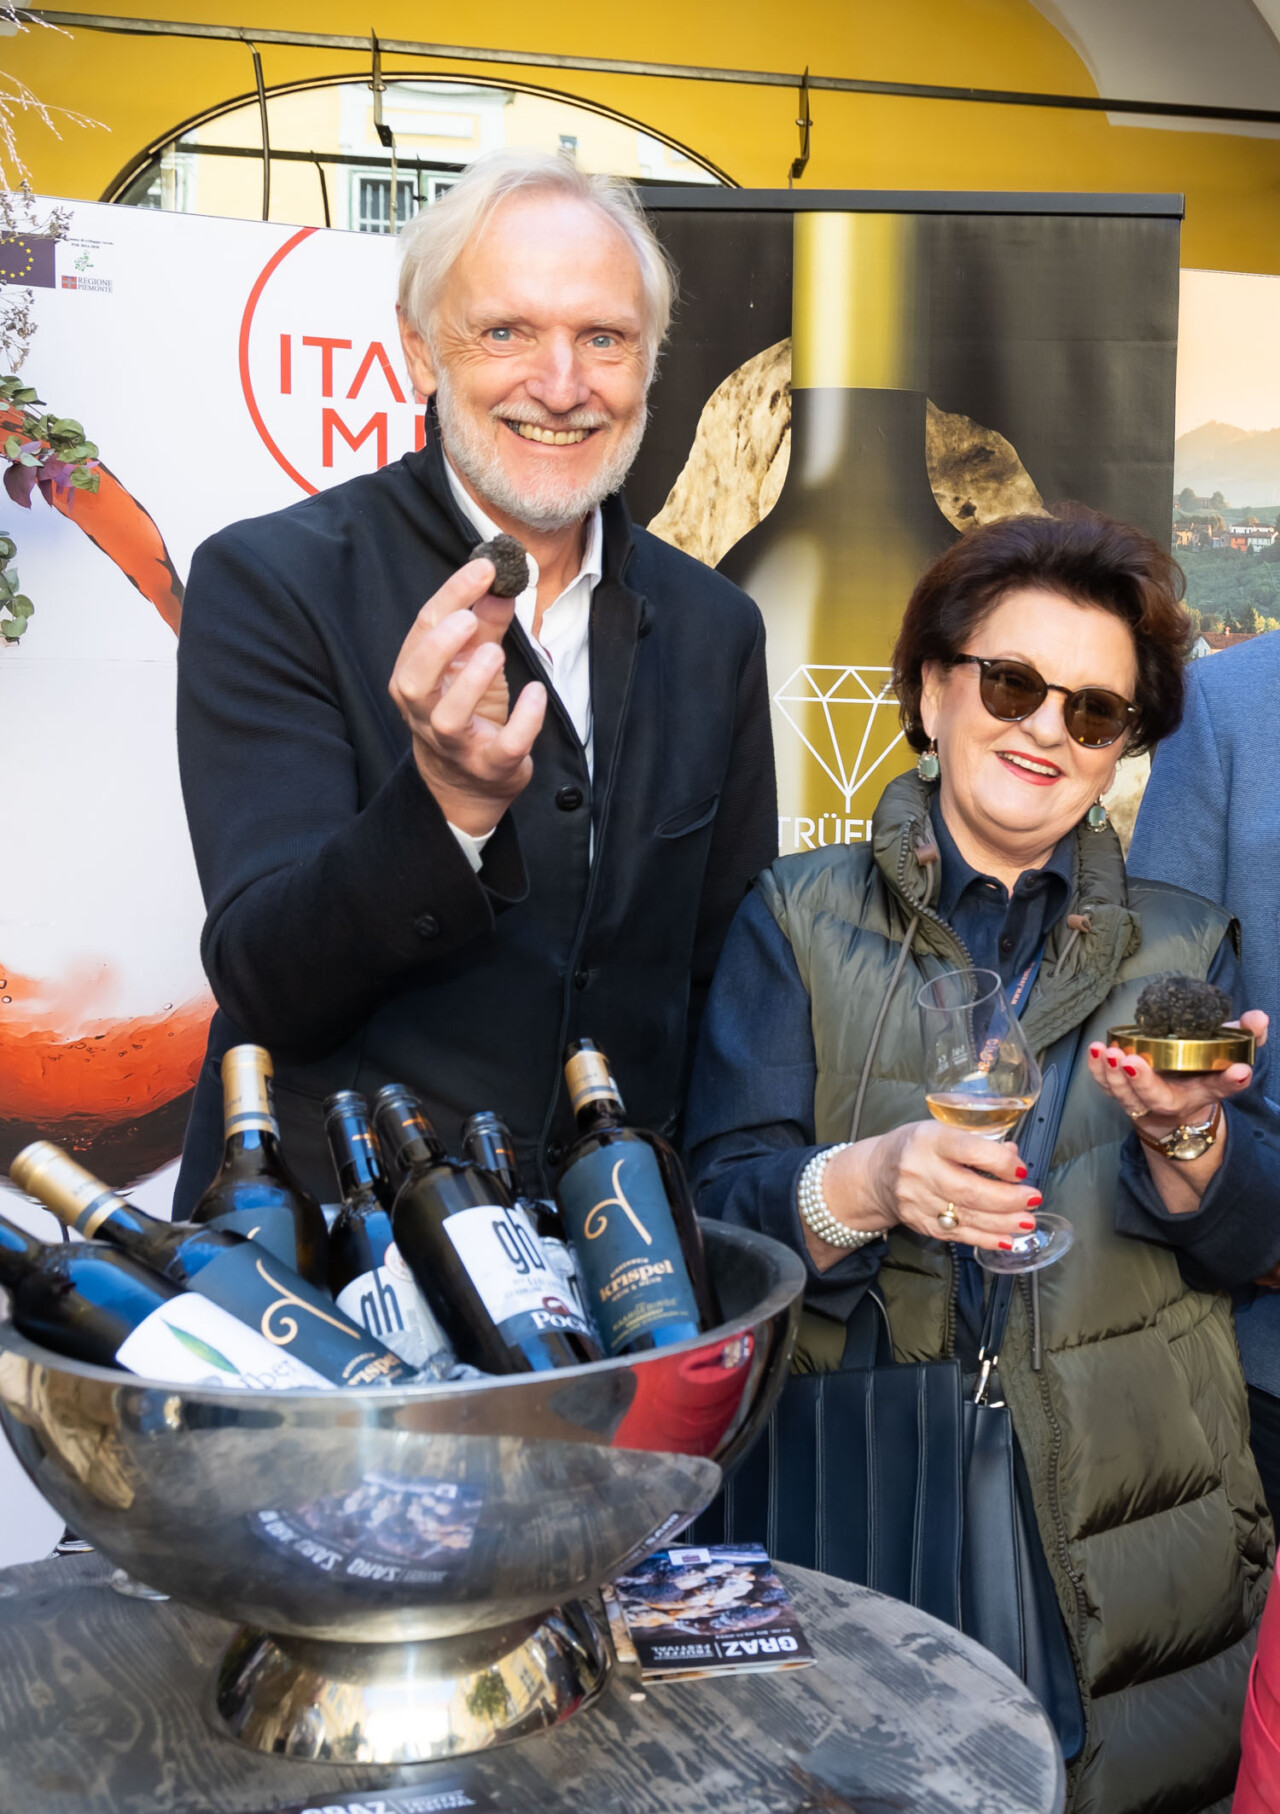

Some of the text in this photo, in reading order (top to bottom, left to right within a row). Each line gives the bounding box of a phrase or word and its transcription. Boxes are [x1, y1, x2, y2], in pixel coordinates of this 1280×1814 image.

[78, 277, 113, 287] REGIONE
[78, 284, 113, 293] PIEMONTE
[599, 1258, 675, 1302] krispel
[721, 1635, 799, 1658] GRAZ
